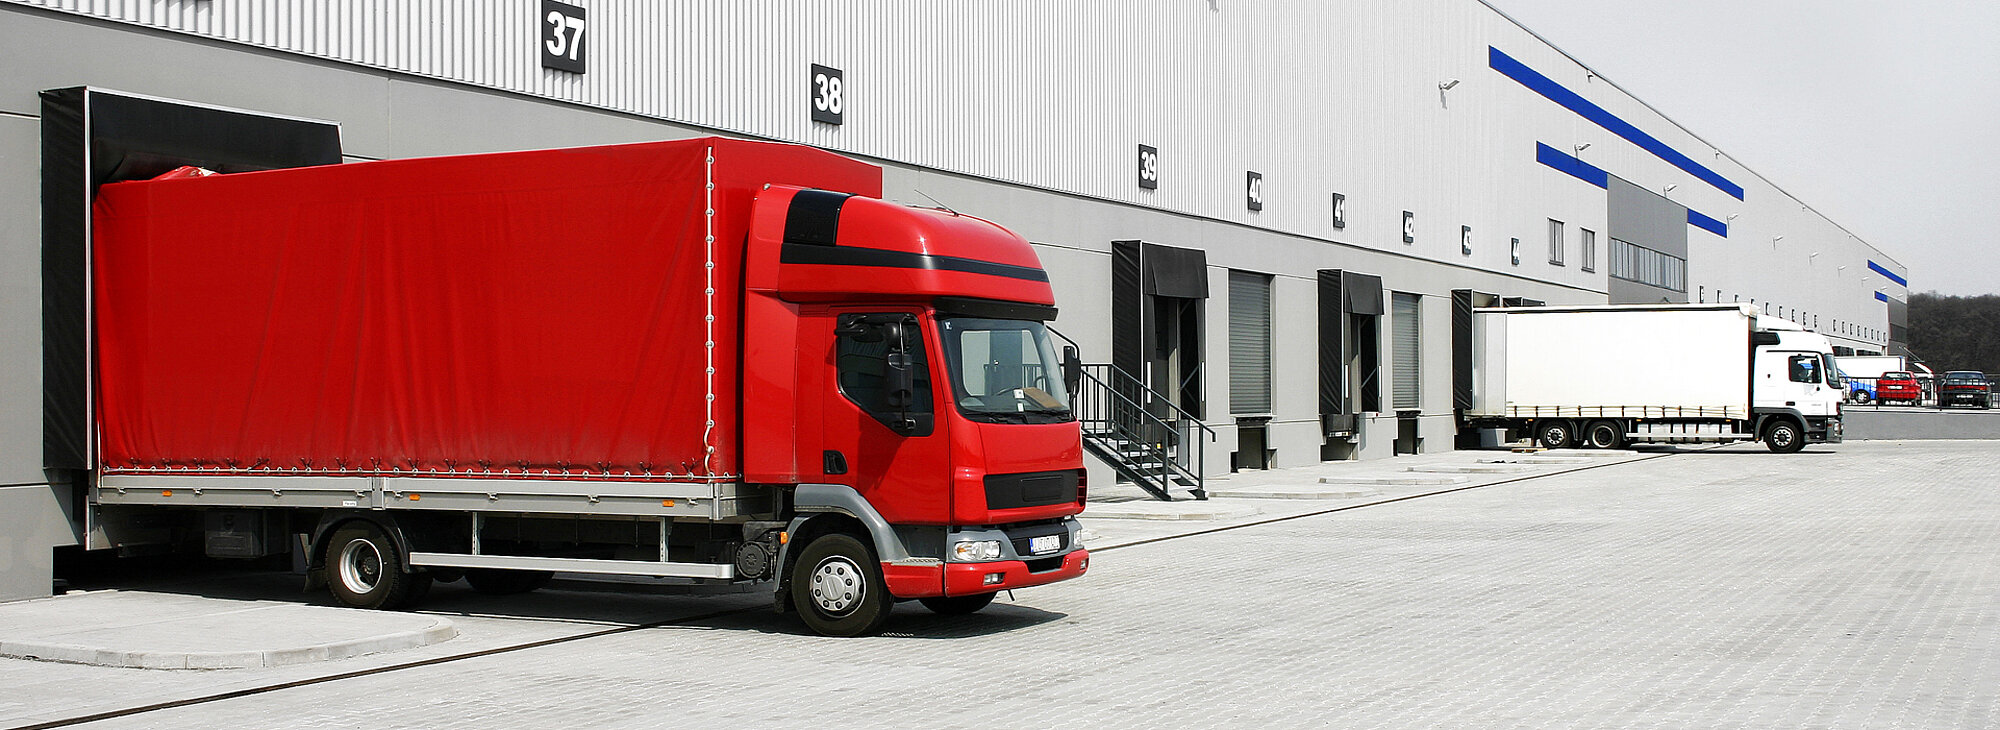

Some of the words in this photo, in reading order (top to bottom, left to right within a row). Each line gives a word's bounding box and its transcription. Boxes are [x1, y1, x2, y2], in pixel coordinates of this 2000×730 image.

[546, 11, 584, 60] 37
[815, 73, 842, 114] 38
[1141, 151, 1157, 181] 39
[1249, 178, 1262, 203] 40
[1335, 199, 1345, 222] 41
[1405, 217, 1414, 237] 42
